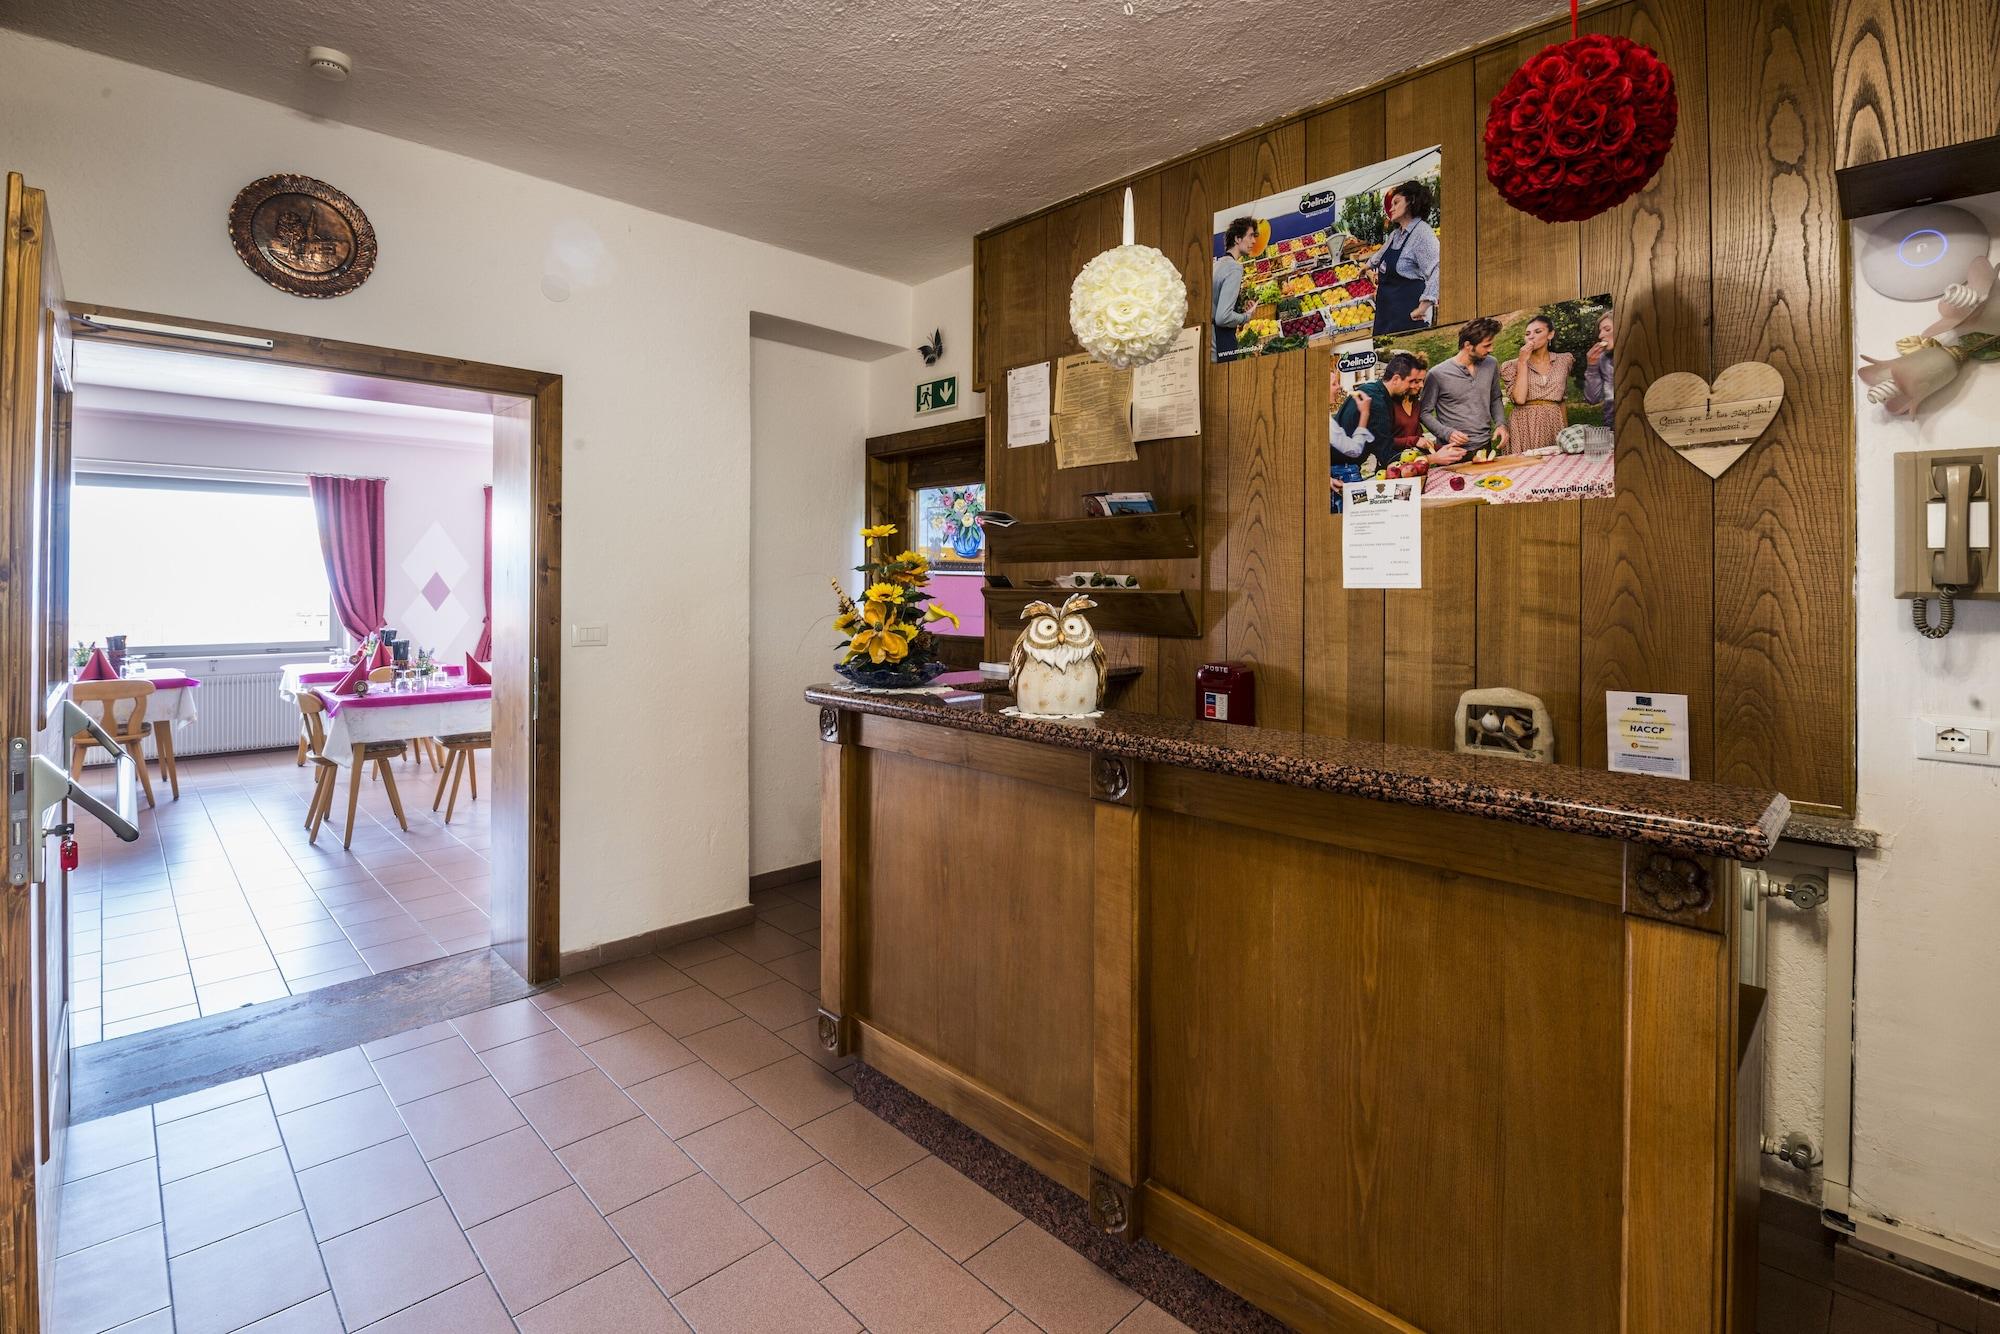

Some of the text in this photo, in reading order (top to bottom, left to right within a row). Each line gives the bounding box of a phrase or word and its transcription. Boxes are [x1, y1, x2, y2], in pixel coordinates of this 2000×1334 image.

[1300, 193, 1334, 210] Melinda
[1338, 354, 1376, 369] Melinda
[1531, 483, 1604, 495] www.melinda.it
[1203, 665, 1229, 673] POSTE
[1630, 725, 1665, 734] HACCP
